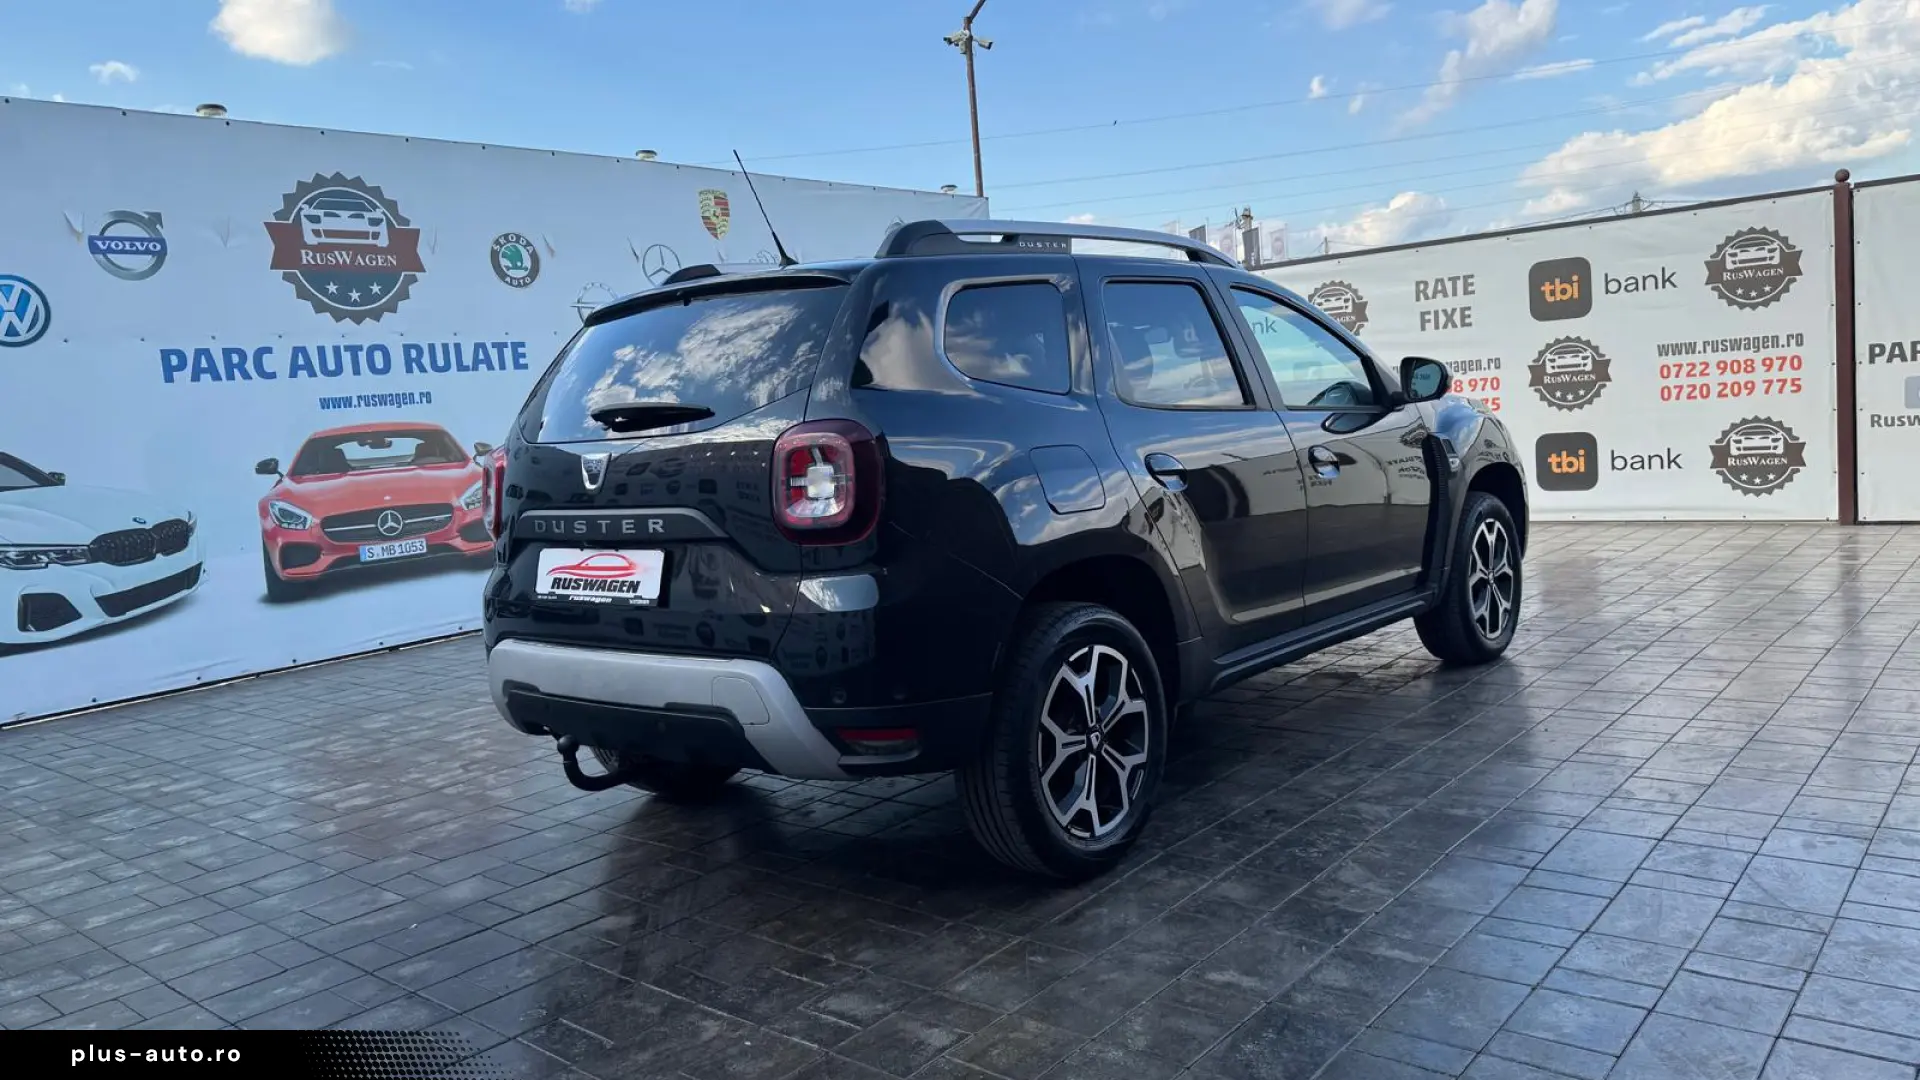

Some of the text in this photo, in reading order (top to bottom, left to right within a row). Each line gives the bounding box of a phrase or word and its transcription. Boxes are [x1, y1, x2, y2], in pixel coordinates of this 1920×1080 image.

[93, 239, 161, 251] VOLVO
[1019, 241, 1067, 249] DUSTER
[504, 277, 531, 286] AUTO
[1415, 274, 1476, 302] RATE
[1540, 266, 1677, 302] tbi bank
[1420, 306, 1473, 332] FIXE
[1657, 332, 1804, 357] www.ruswagen.ro
[159, 341, 529, 383] PARC AUTO RULATE
[1659, 355, 1803, 380] 0722 908 970
[1468, 376, 1501, 392] 970
[1660, 377, 1802, 401] 0720 209 775
[319, 391, 432, 410] www.ruswagen.ro
[1547, 448, 1683, 473] tbi bank
[534, 519, 665, 534] DUSTER
[551, 577, 641, 594] RUSWAGEN
